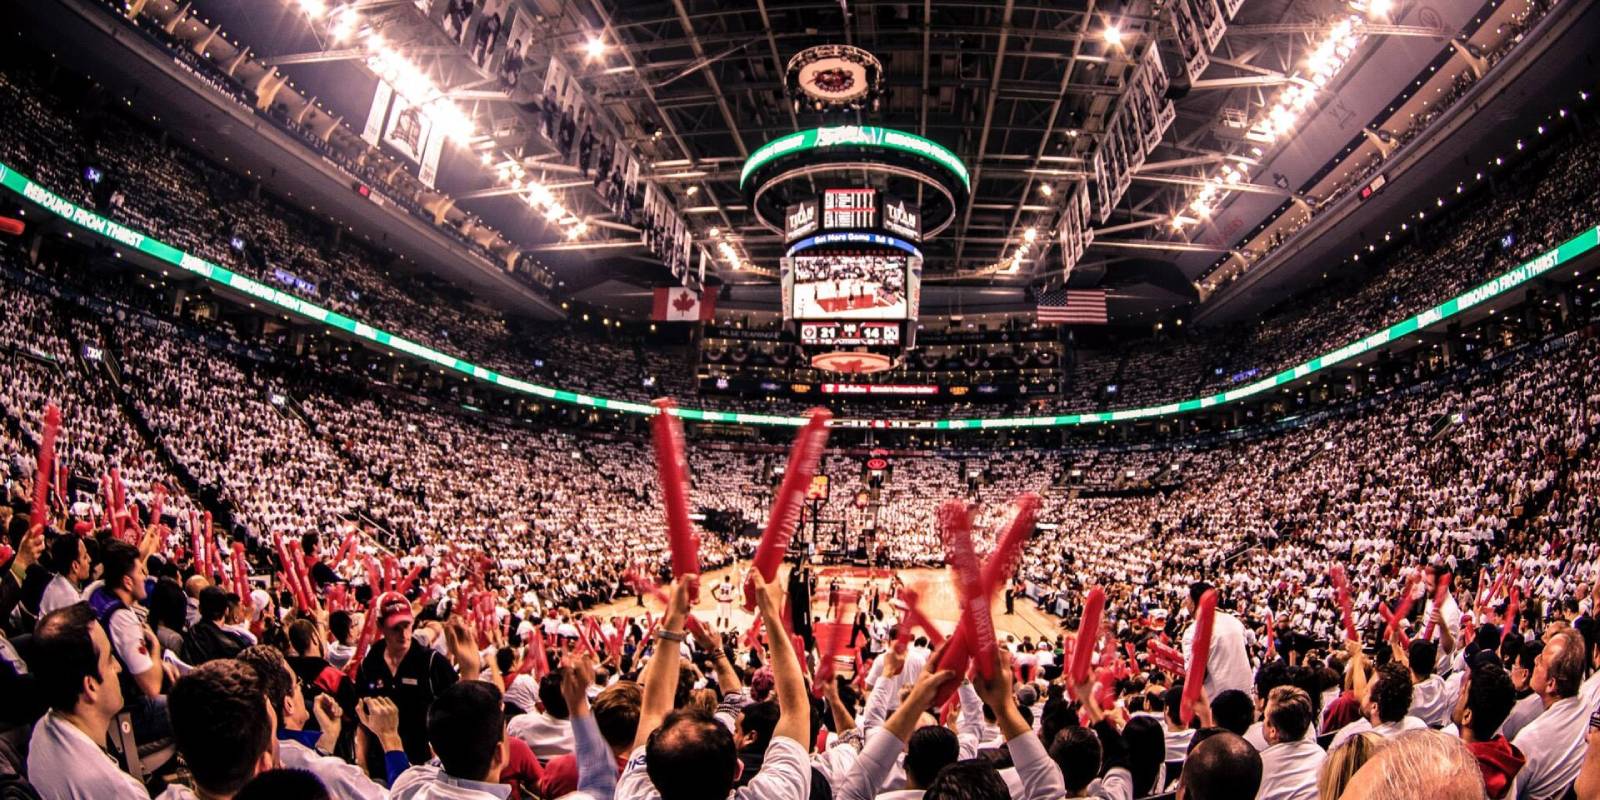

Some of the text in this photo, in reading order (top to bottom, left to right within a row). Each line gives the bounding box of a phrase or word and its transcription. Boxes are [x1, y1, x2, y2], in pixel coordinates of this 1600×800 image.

[23, 181, 144, 248] REBOUND FROM THIRST
[886, 201, 917, 228] TITAN
[1457, 249, 1559, 311] REBOUND FROM THIRST
[820, 327, 836, 338] 21
[863, 327, 880, 338] 14
